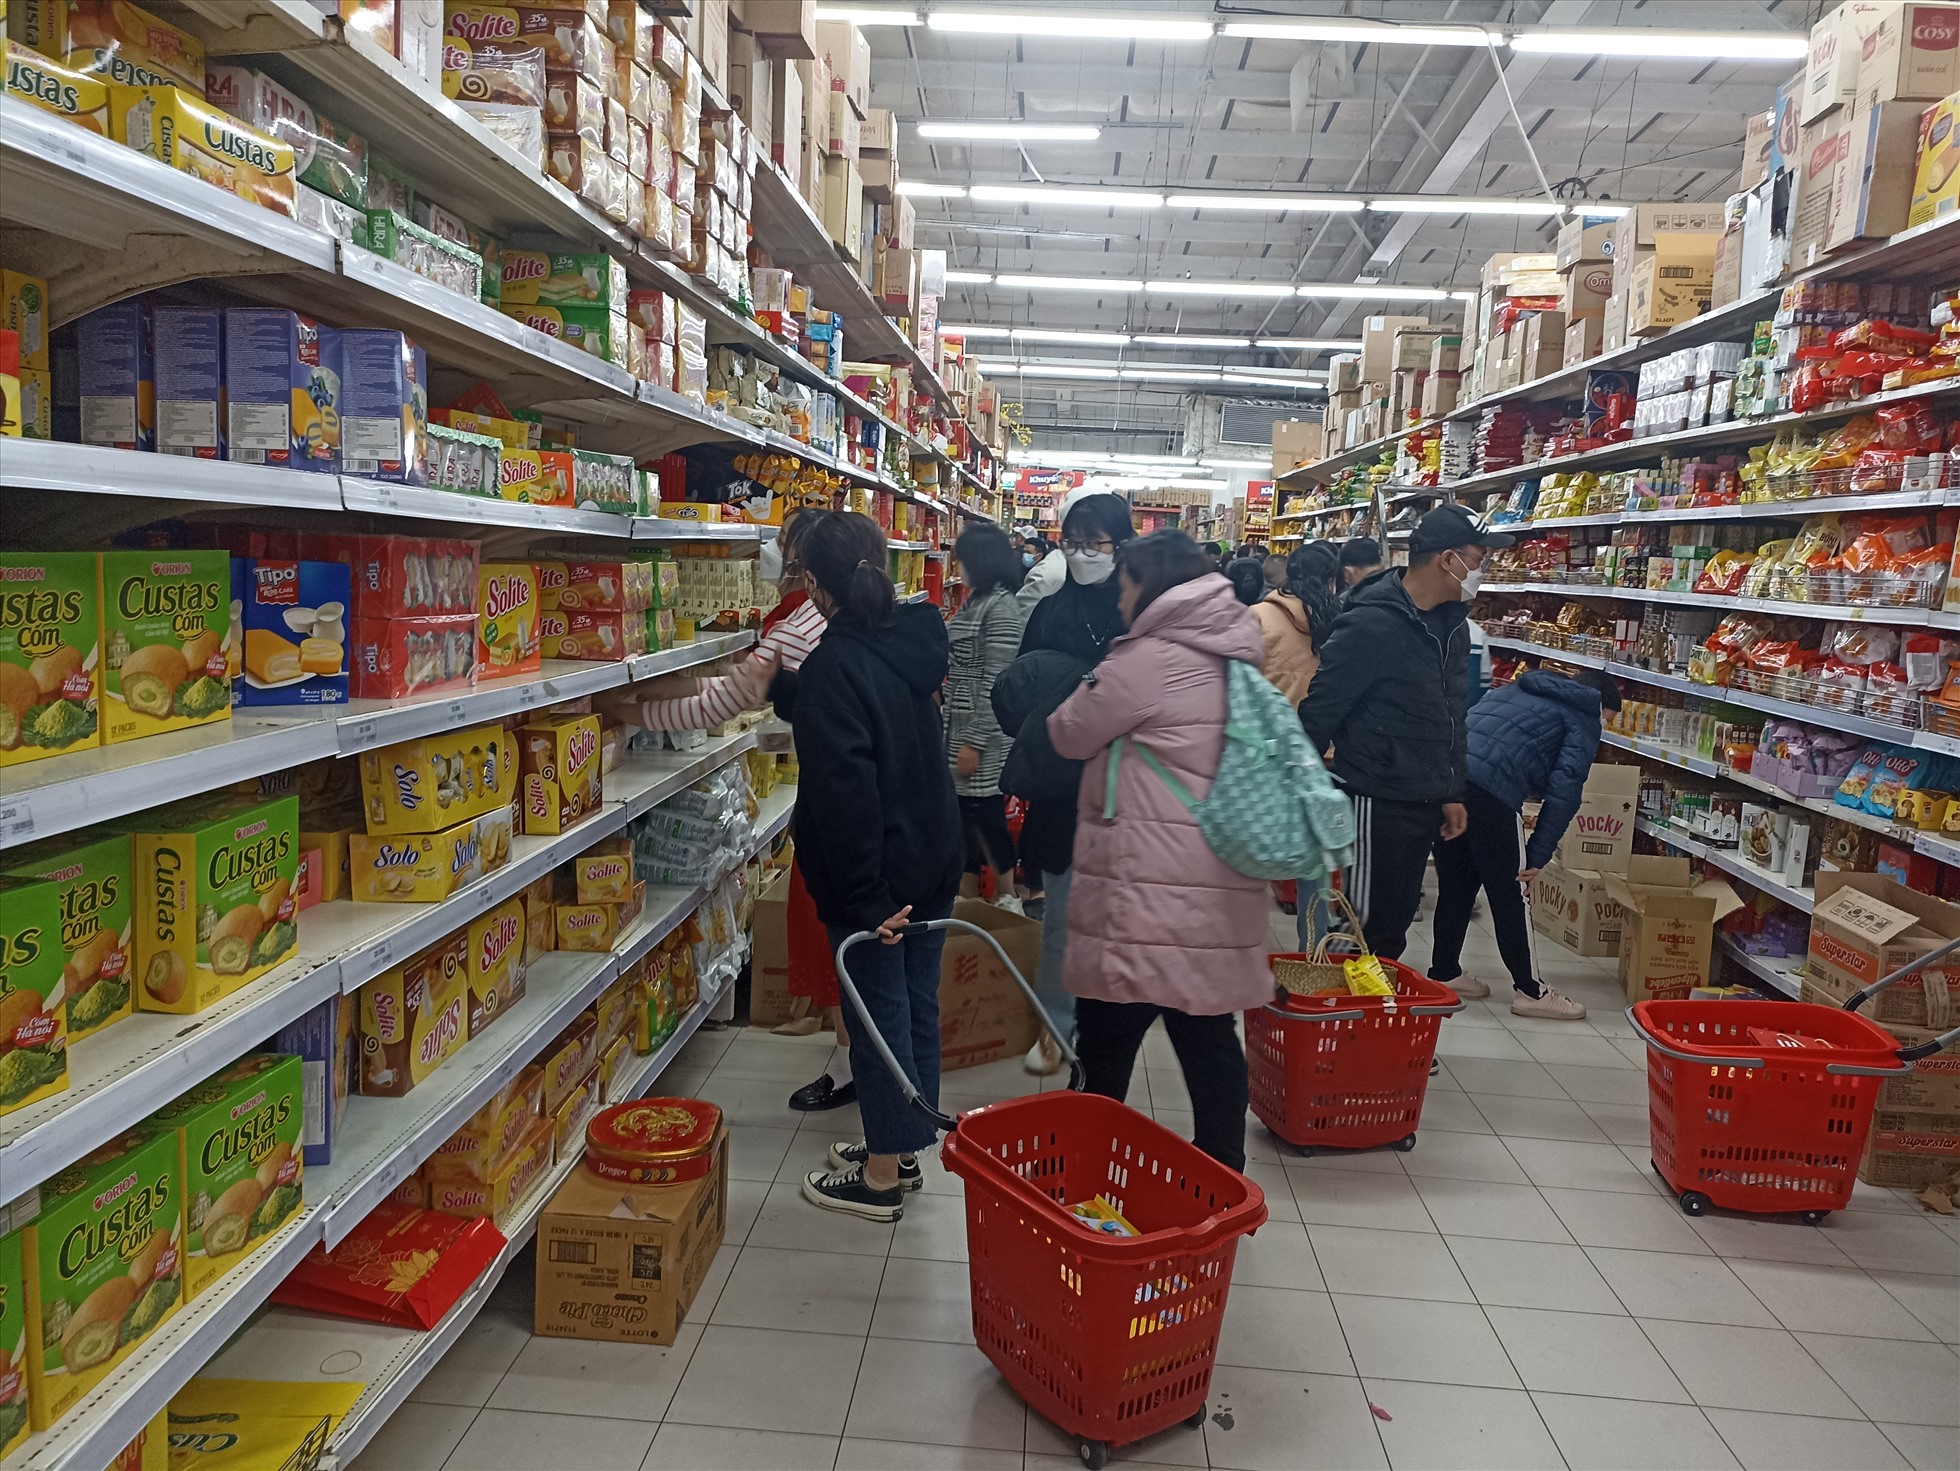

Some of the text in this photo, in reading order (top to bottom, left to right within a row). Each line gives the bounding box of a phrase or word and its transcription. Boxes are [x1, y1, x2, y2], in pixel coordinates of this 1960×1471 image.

[446, 12, 517, 41] Solite
[1914, 27, 1955, 40] COSY
[205, 116, 277, 174] Custas
[373, 215, 386, 251] HURA
[501, 257, 546, 282] olite
[526, 315, 559, 338] lite
[501, 459, 538, 485] Solite
[5, 567, 45, 581] ORION
[161, 563, 191, 575] ORION
[254, 566, 298, 586] Tipo
[366, 561, 379, 591] Tipo
[0, 590, 82, 627] stas
[118, 576, 221, 619] Custas
[486, 575, 529, 620] Solite
[366, 643, 379, 674] Tipo
[567, 728, 596, 774] Solite
[394, 765, 420, 810] Solo
[529, 778, 545, 818] Solite
[208, 831, 290, 890] Custas
[372, 844, 420, 868] Solo
[451, 838, 476, 873] Solo
[586, 864, 622, 880] Solite
[58, 874, 120, 918] stas
[155, 847, 182, 942] Custas
[567, 913, 602, 930] Solite
[1594, 903, 1623, 920] Poc
[481, 917, 518, 973] Solite
[1820, 937, 1867, 972] Superstar
[373, 991, 395, 1039] Solite
[420, 997, 461, 1065] Solite
[201, 1094, 291, 1176] Custas
[438, 1137, 479, 1154] Solite
[1898, 1135, 1957, 1149] Superstar
[104, 1172, 138, 1202] ORION
[508, 1159, 536, 1206] Solite
[441, 1189, 487, 1210] Solite
[57, 1174, 170, 1280] Custas
[559, 1301, 648, 1323] Choco Pie
